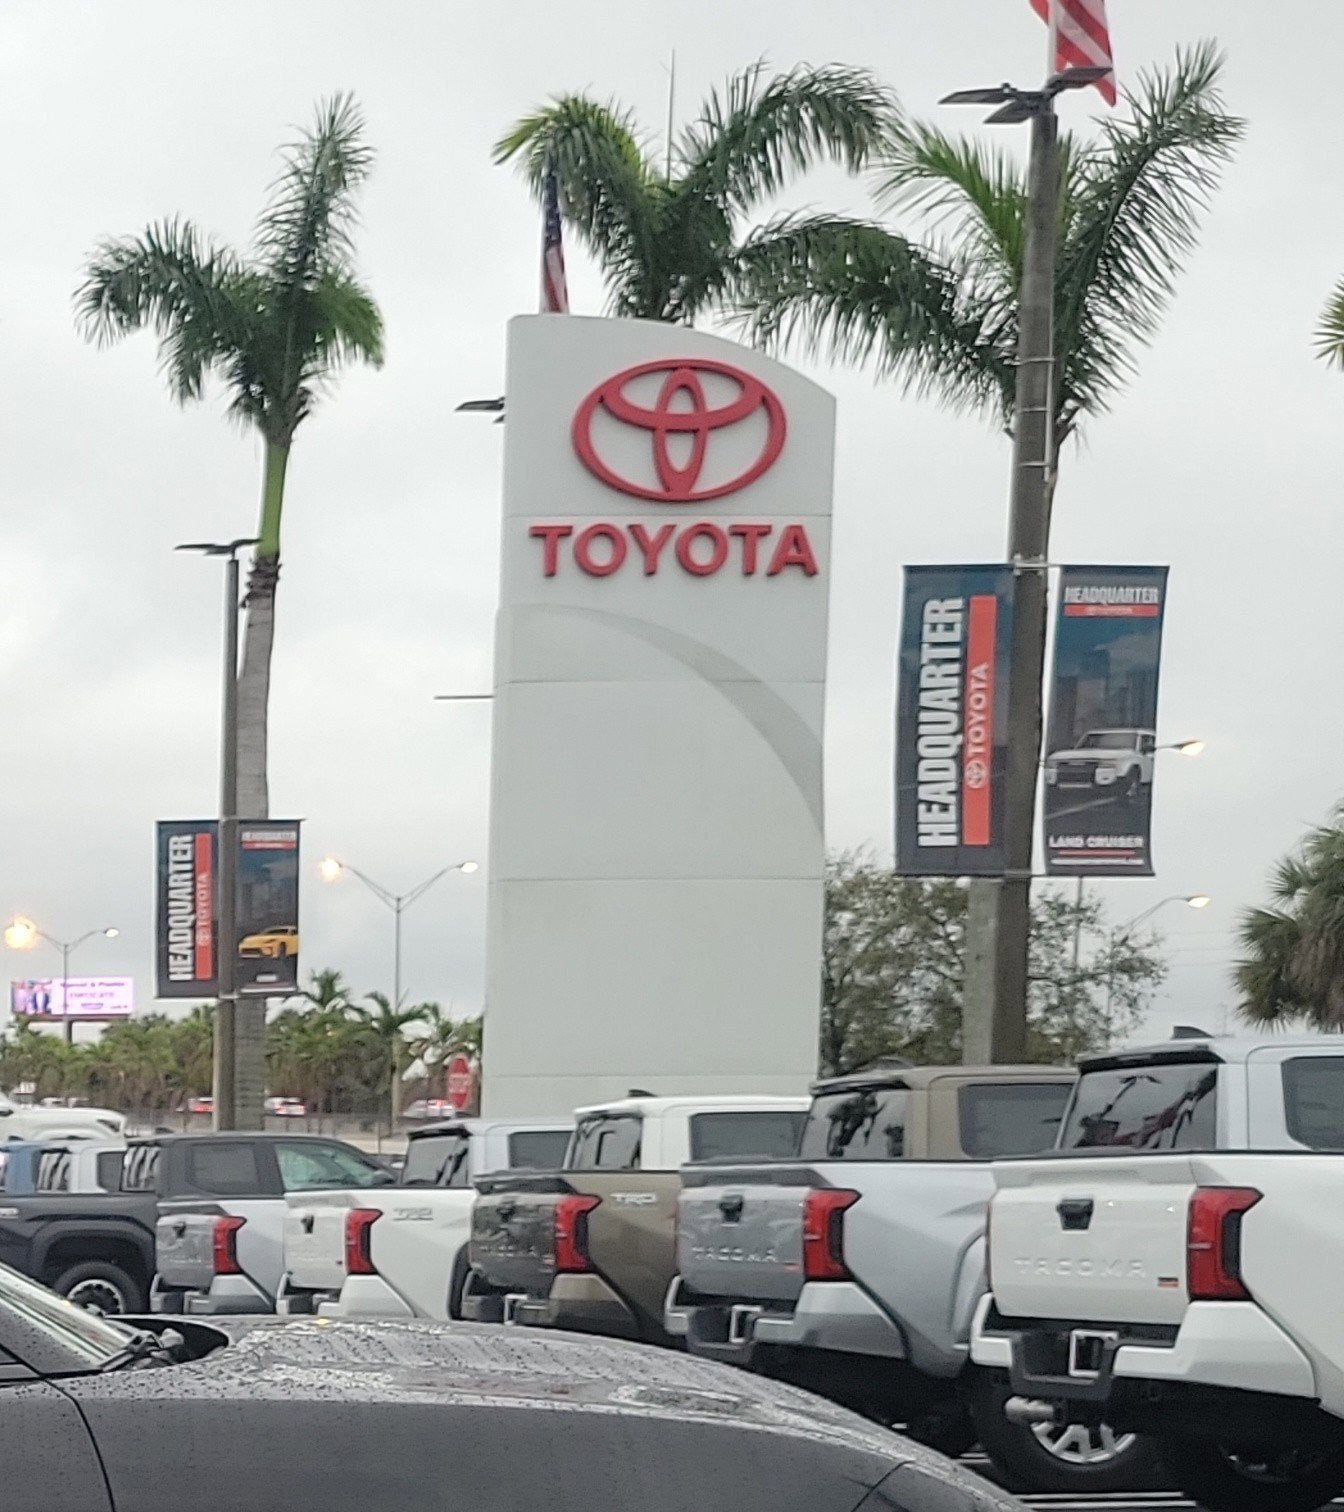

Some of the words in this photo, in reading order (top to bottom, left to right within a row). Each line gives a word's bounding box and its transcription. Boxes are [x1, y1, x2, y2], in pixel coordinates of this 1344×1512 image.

[528, 523, 819, 578] TOYOTA
[1065, 586, 1159, 606] HEADQUARTER
[917, 597, 965, 847] HEADQUARTER
[967, 662, 991, 756] TOYOTA
[168, 834, 194, 982] HEADQUARTER
[610, 1192, 656, 1205] TRD
[1013, 1257, 1148, 1278] TACOMA
